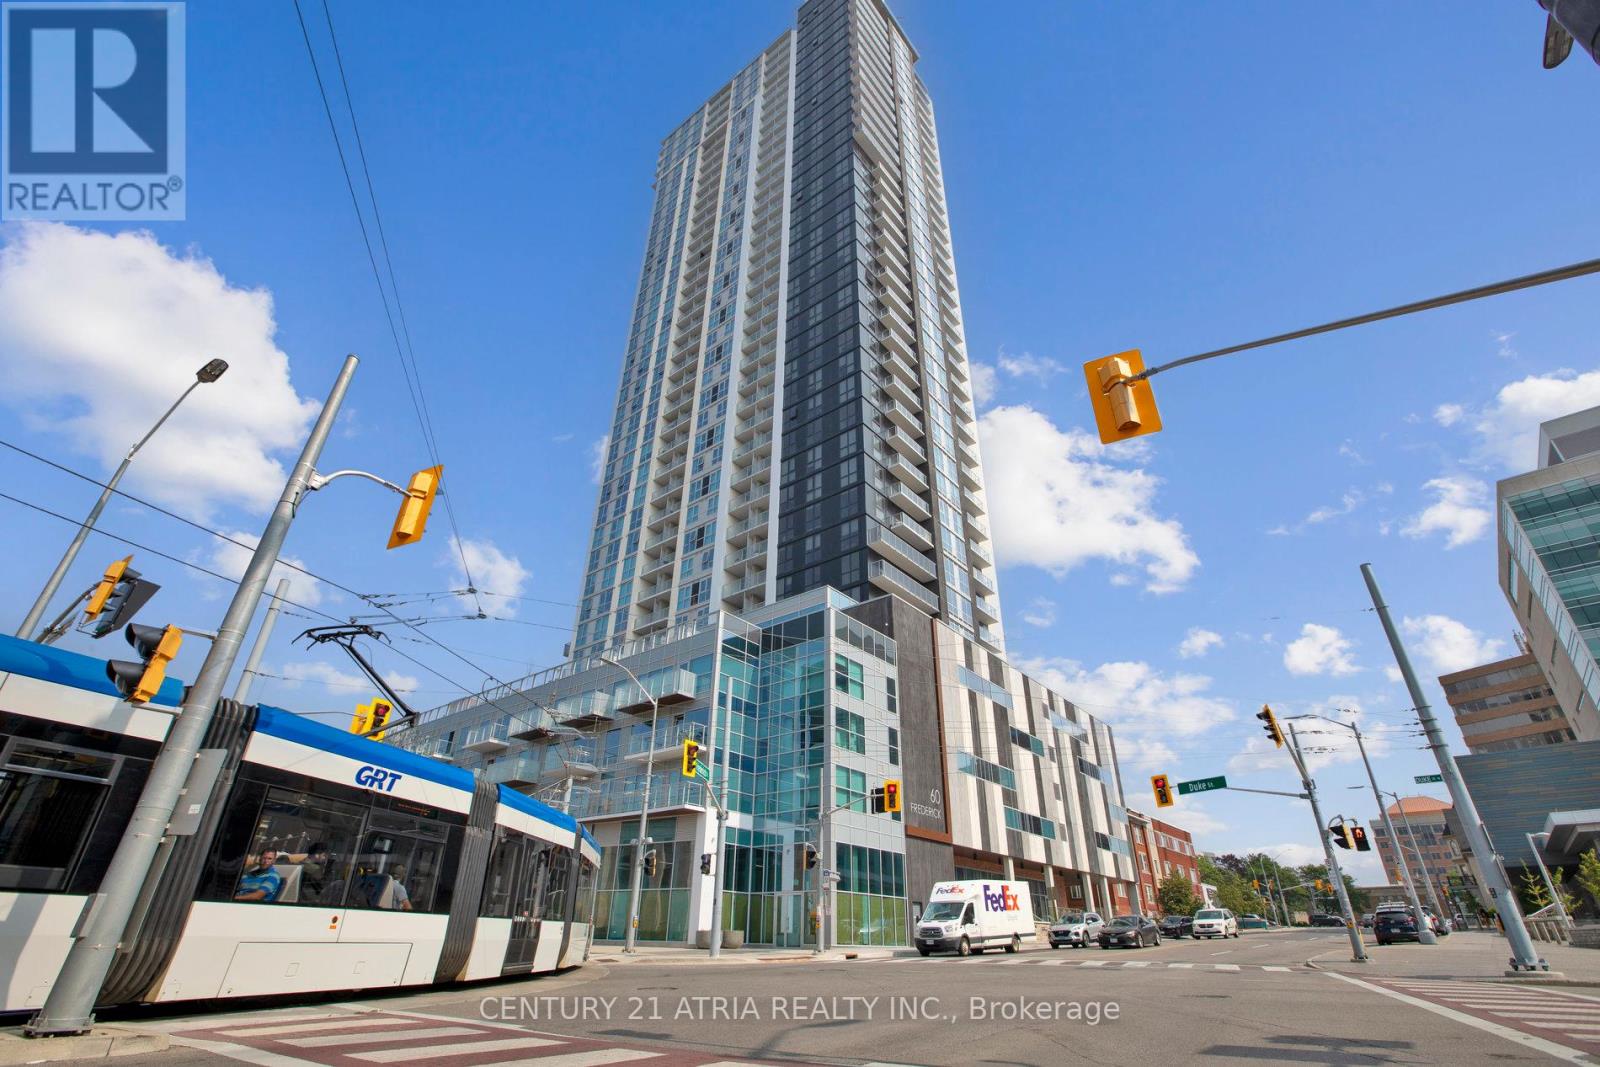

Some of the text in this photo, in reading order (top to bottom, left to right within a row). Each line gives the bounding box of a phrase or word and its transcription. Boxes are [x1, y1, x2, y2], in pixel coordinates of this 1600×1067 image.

[355, 766, 402, 792] GRT
[1189, 781, 1207, 792] Duke
[930, 788, 941, 805] 60
[911, 802, 942, 819] FREDERICK
[936, 885, 965, 895] FedEx
[983, 885, 1020, 912] FedEx
